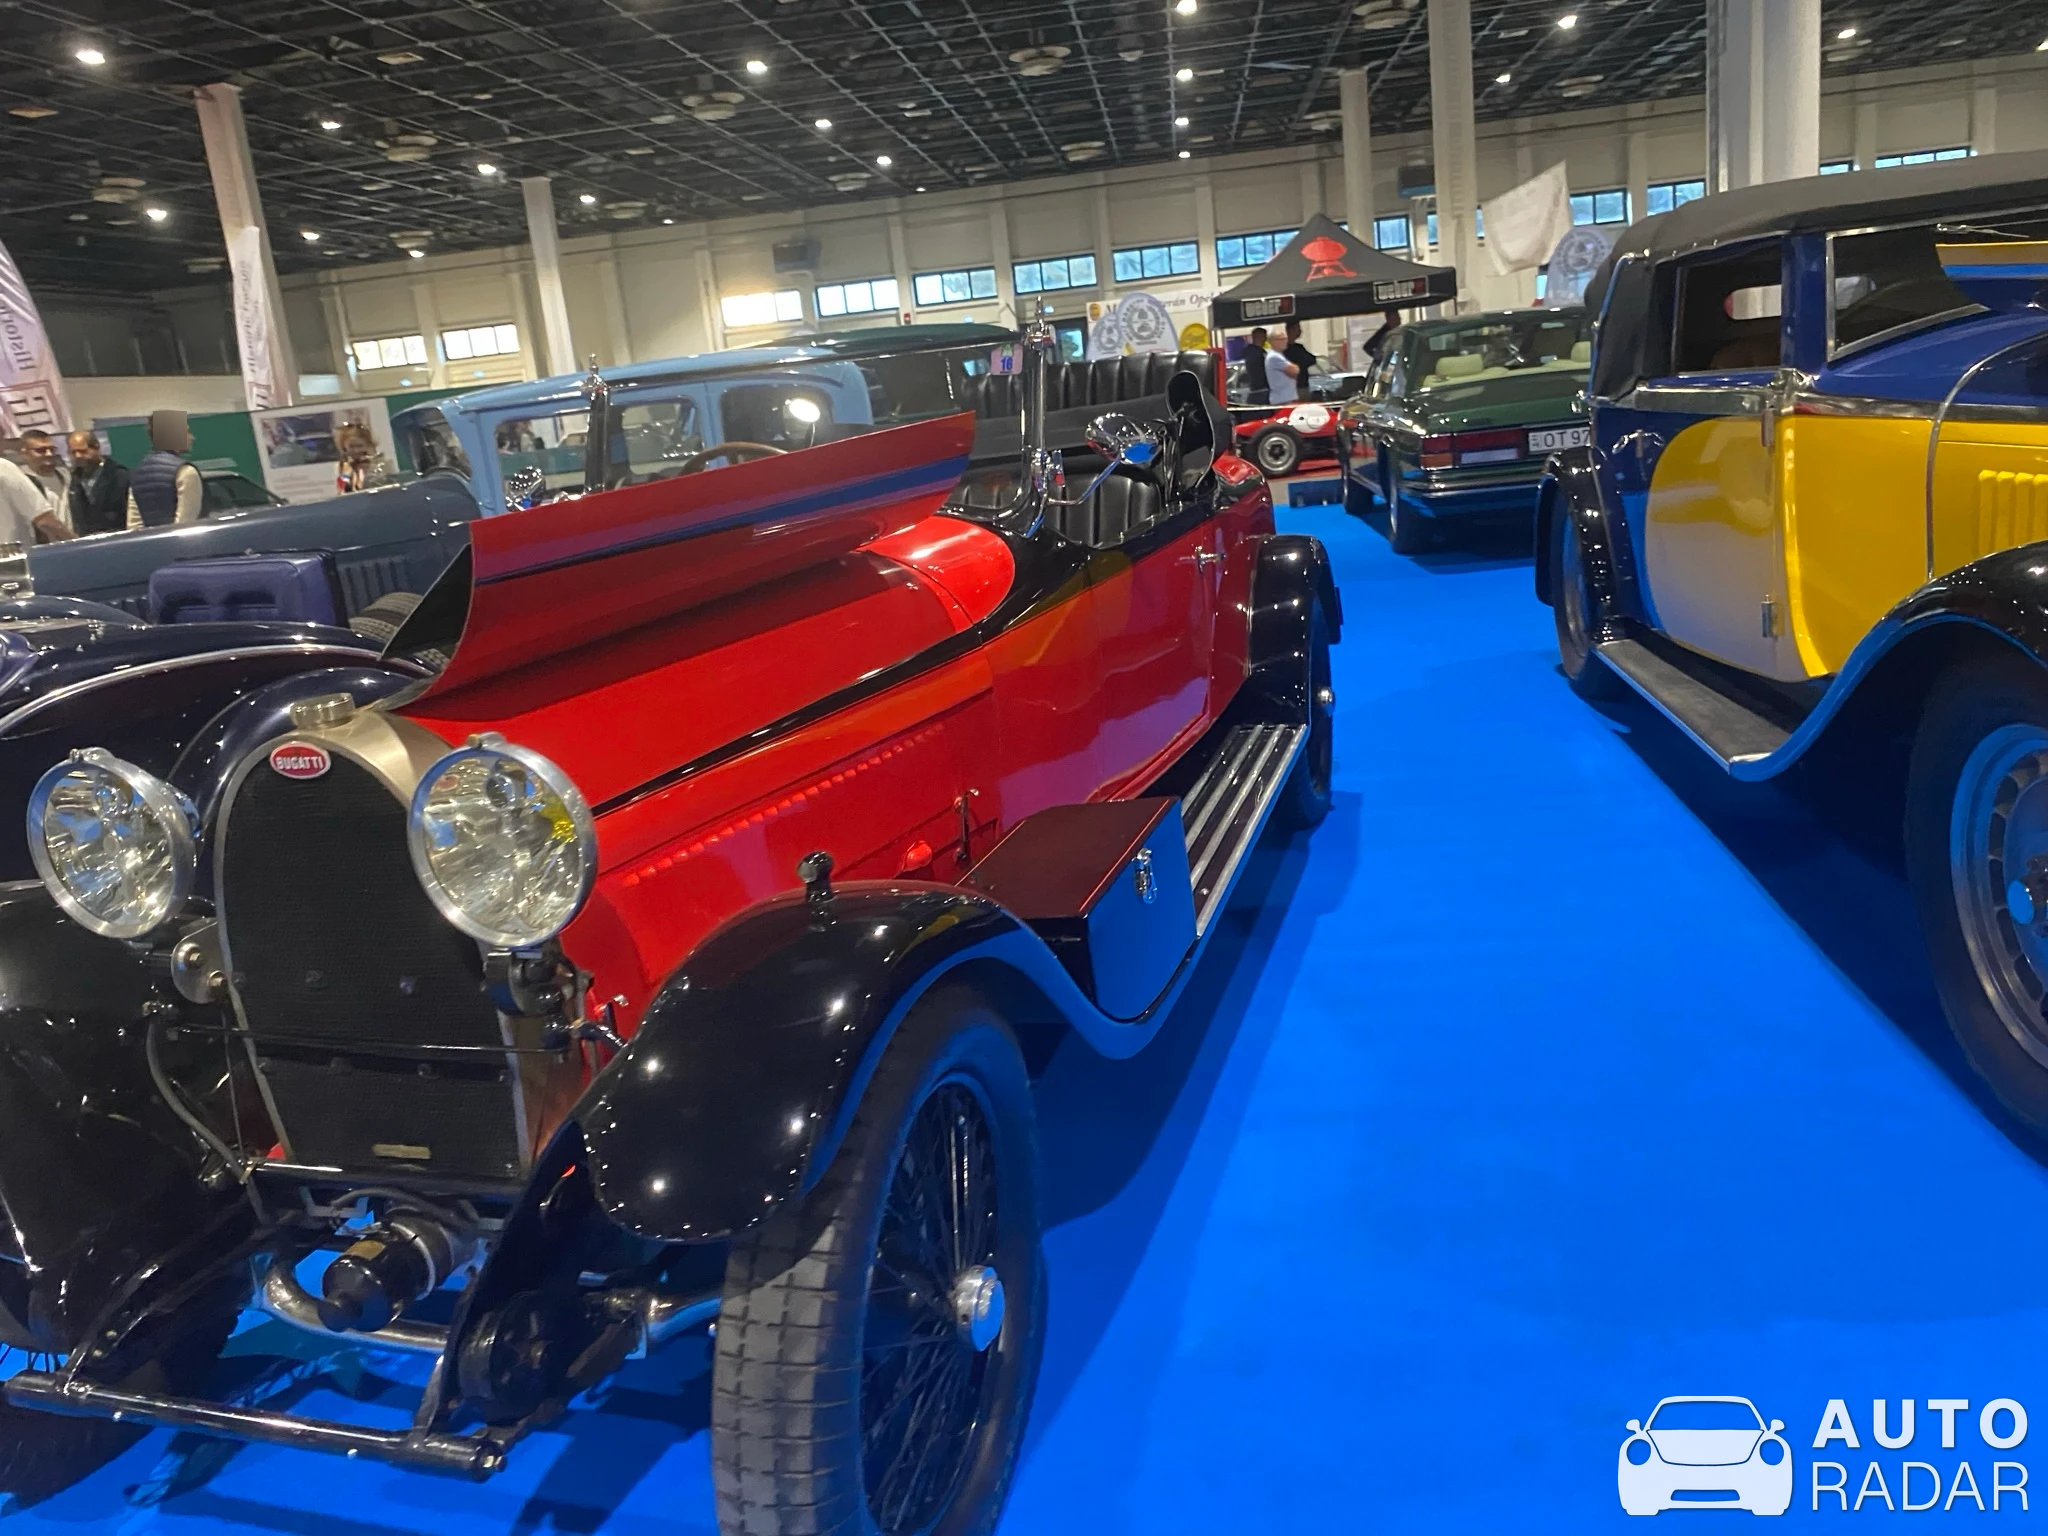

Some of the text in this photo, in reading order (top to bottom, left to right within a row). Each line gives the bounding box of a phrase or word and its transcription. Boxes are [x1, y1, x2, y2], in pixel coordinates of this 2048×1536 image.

[1001, 356, 1013, 370] 16
[1544, 431, 1567, 447] OT
[275, 756, 324, 769] BUGATTI
